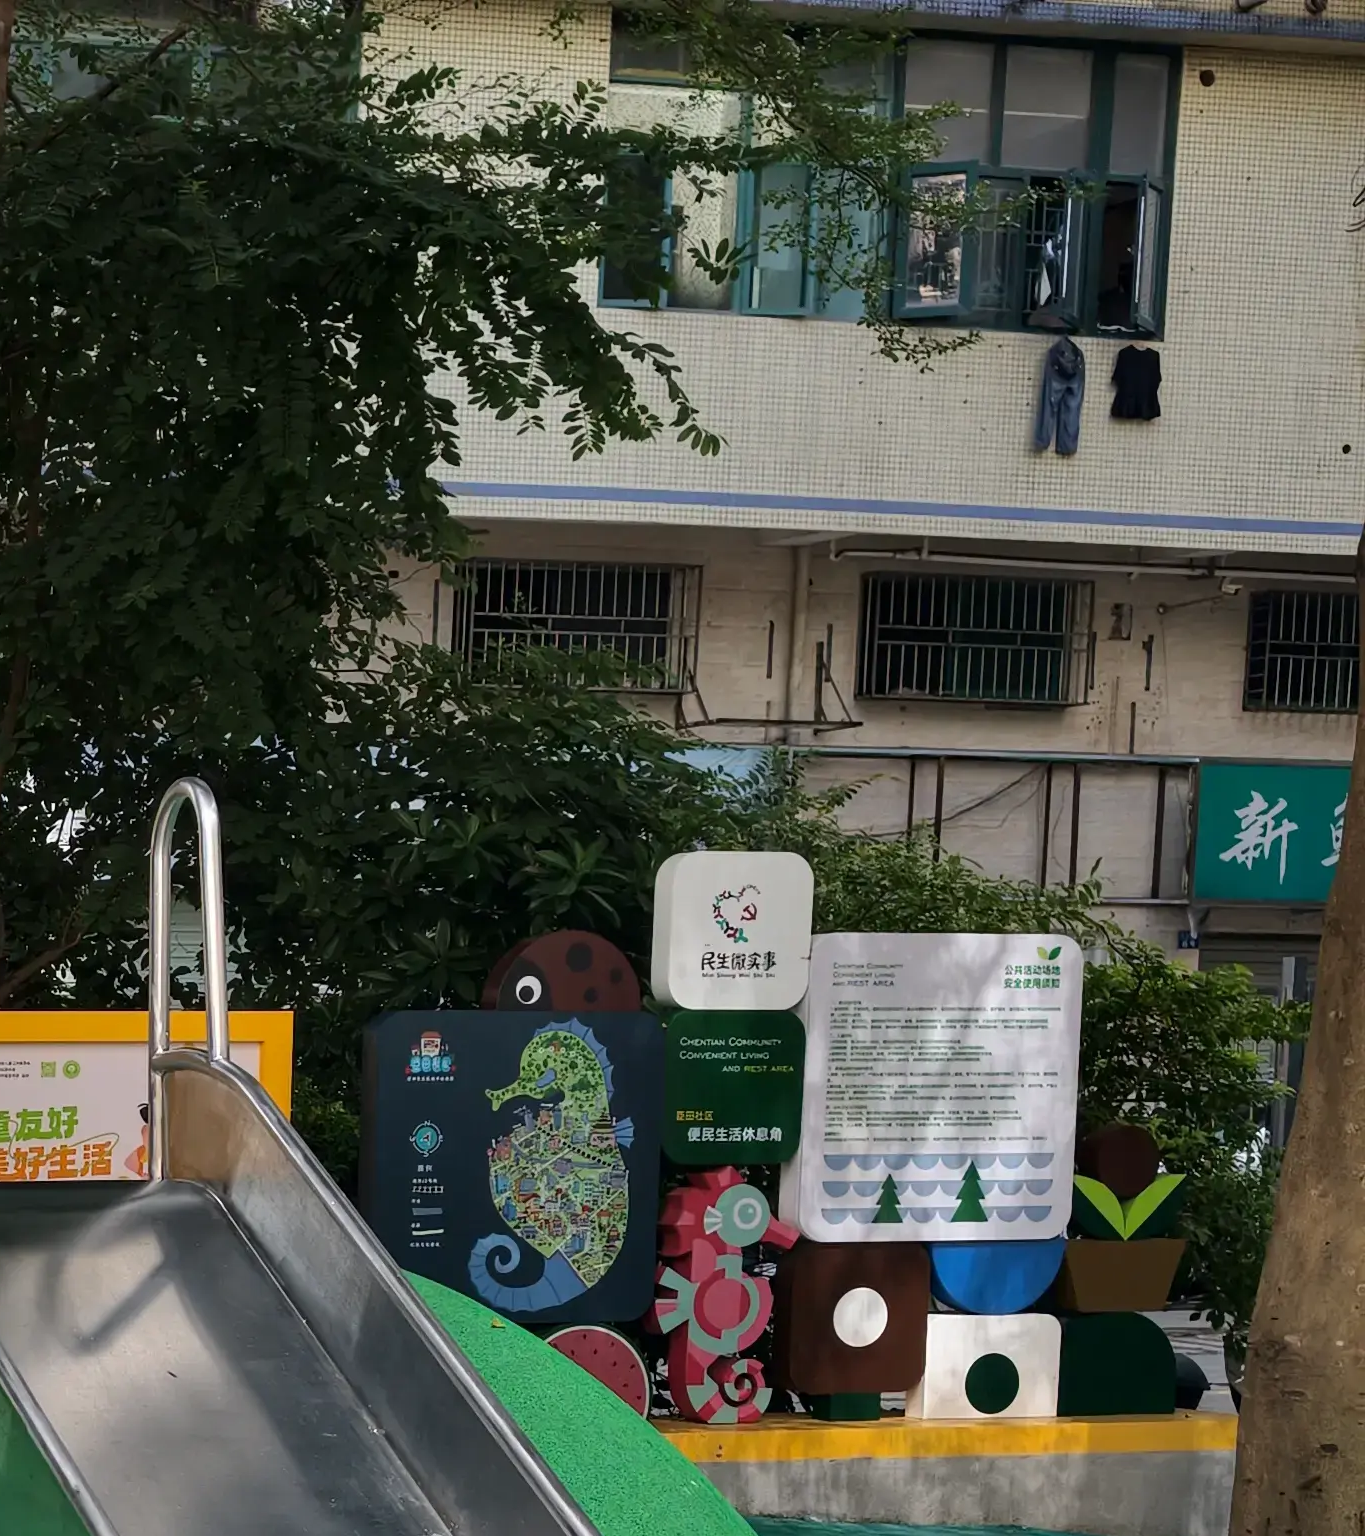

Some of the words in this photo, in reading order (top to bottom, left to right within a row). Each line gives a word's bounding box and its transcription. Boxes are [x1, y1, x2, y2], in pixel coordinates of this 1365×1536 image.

[701, 951, 777, 971] 民生微实事
[687, 1126, 783, 1141] 便民生活休息角
